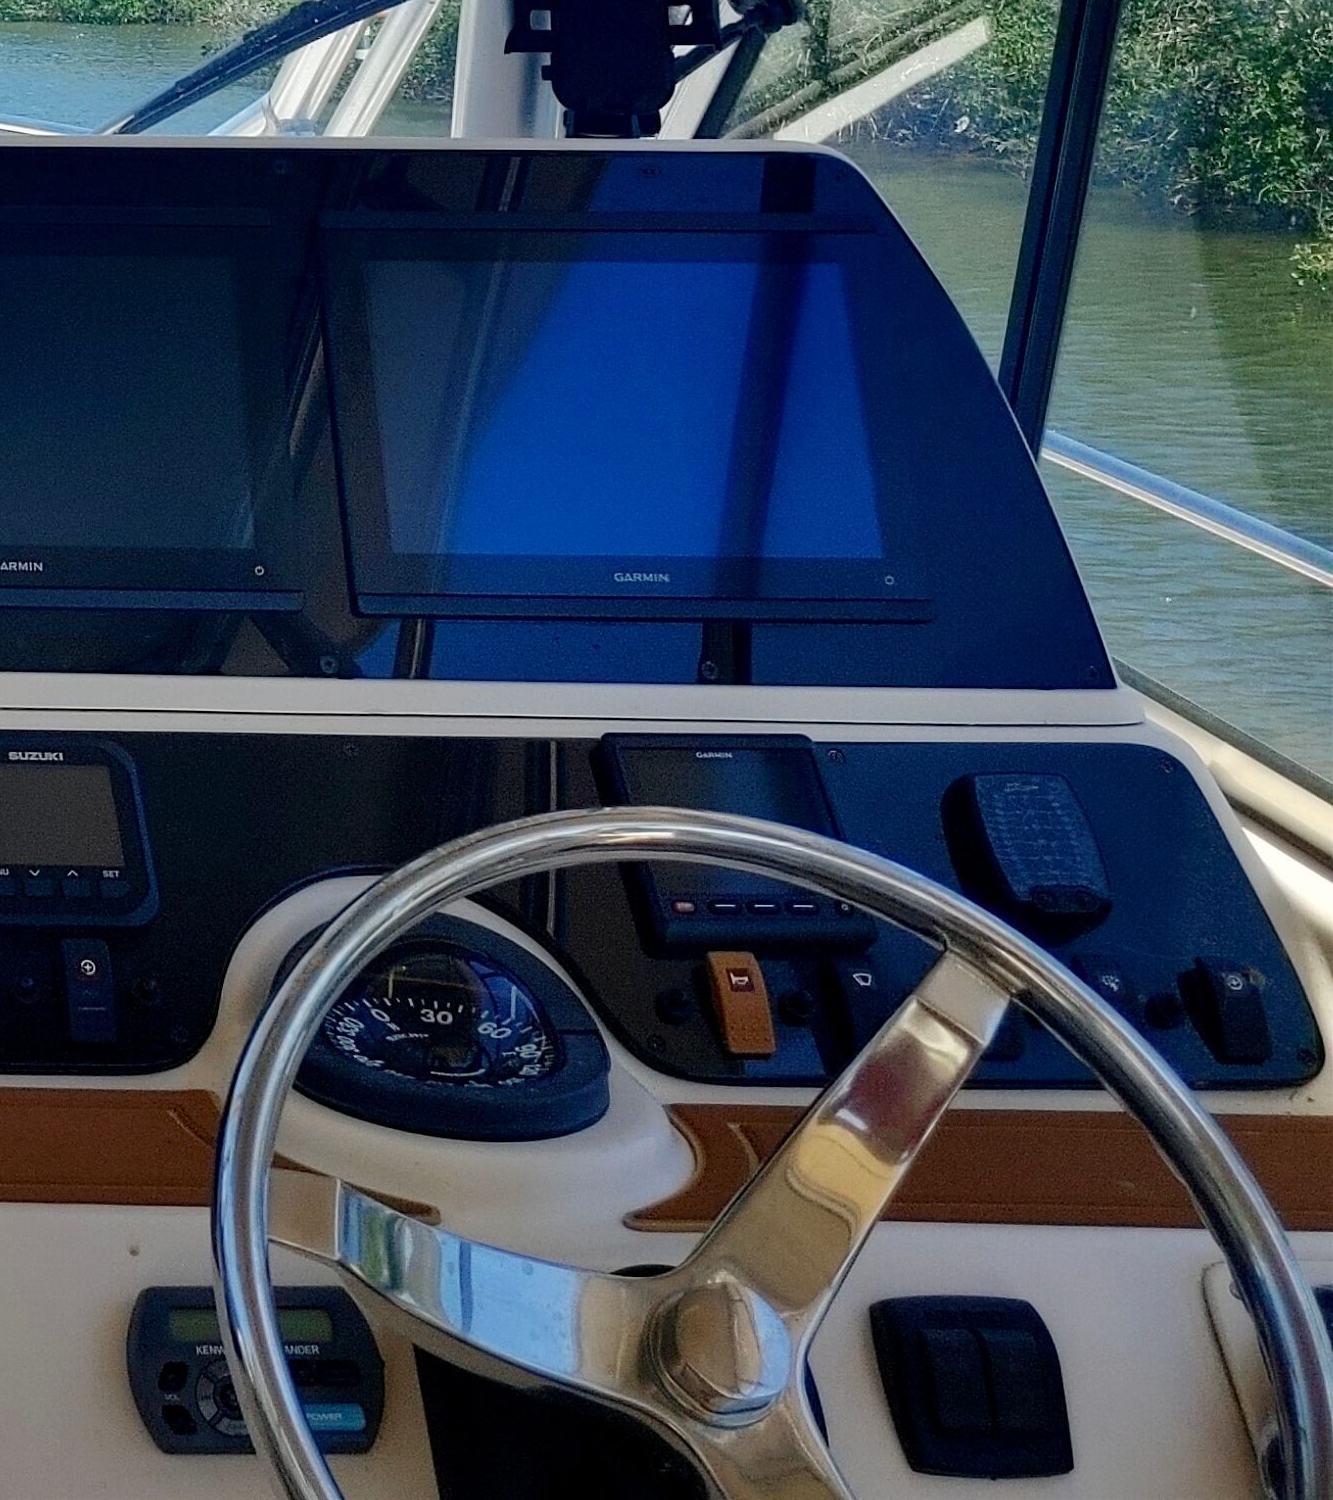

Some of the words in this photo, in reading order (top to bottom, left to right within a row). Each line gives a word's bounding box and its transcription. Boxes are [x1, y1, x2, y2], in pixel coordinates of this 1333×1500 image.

[613, 572, 670, 582] GARMIN
[8, 752, 64, 761] SUZUKI
[695, 751, 733, 759] GARMIN
[102, 870, 120, 878] SET
[420, 1008, 453, 1025] 30
[477, 1021, 512, 1038] 60
